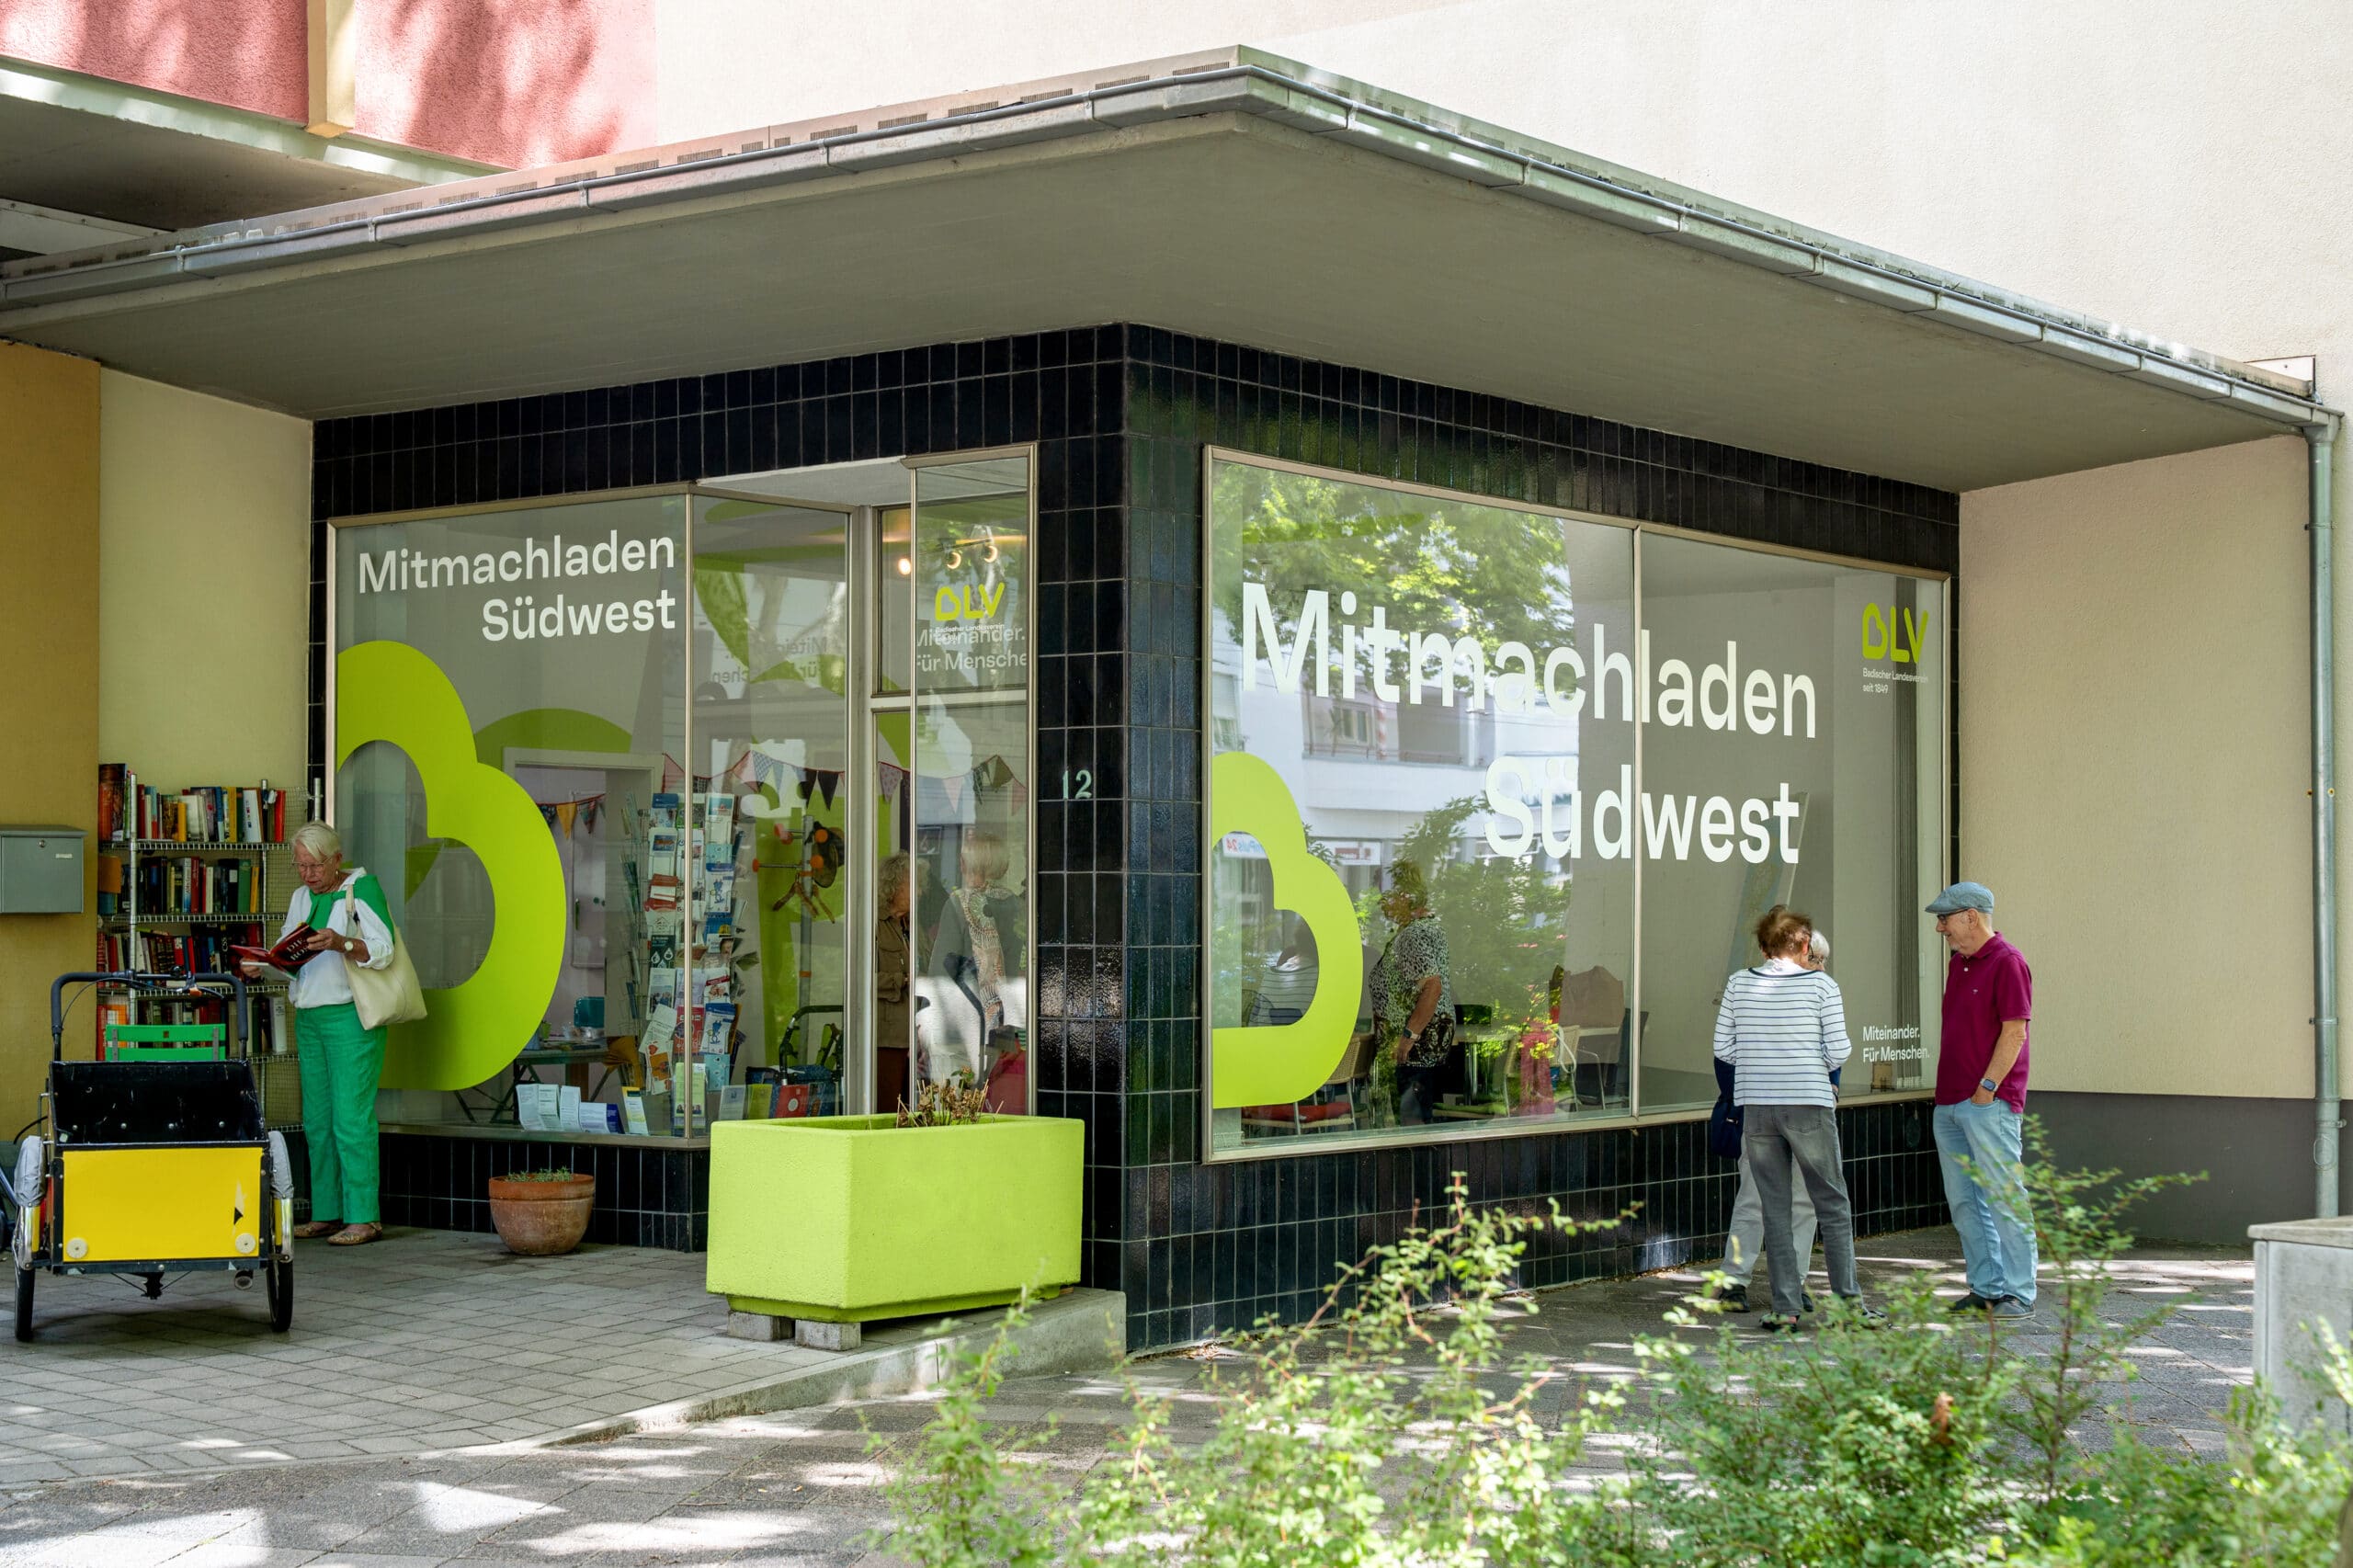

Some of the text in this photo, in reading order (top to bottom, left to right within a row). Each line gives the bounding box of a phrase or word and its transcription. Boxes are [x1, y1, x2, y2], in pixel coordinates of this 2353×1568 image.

[358, 529, 675, 594] Mitmachladen
[482, 589, 676, 642] Südwest
[935, 582, 1006, 621] BLV
[1862, 602, 1929, 664] BLV
[917, 649, 1027, 672] ür Mensche
[1242, 582, 1816, 738] Mitmachladen
[1862, 667, 1892, 680] Badischer
[1063, 769, 1092, 800] 12
[1484, 756, 1800, 864] Südwest
[1862, 1024, 1920, 1041] Miteinander.
[1862, 1045, 1930, 1063] Für Menschen.
